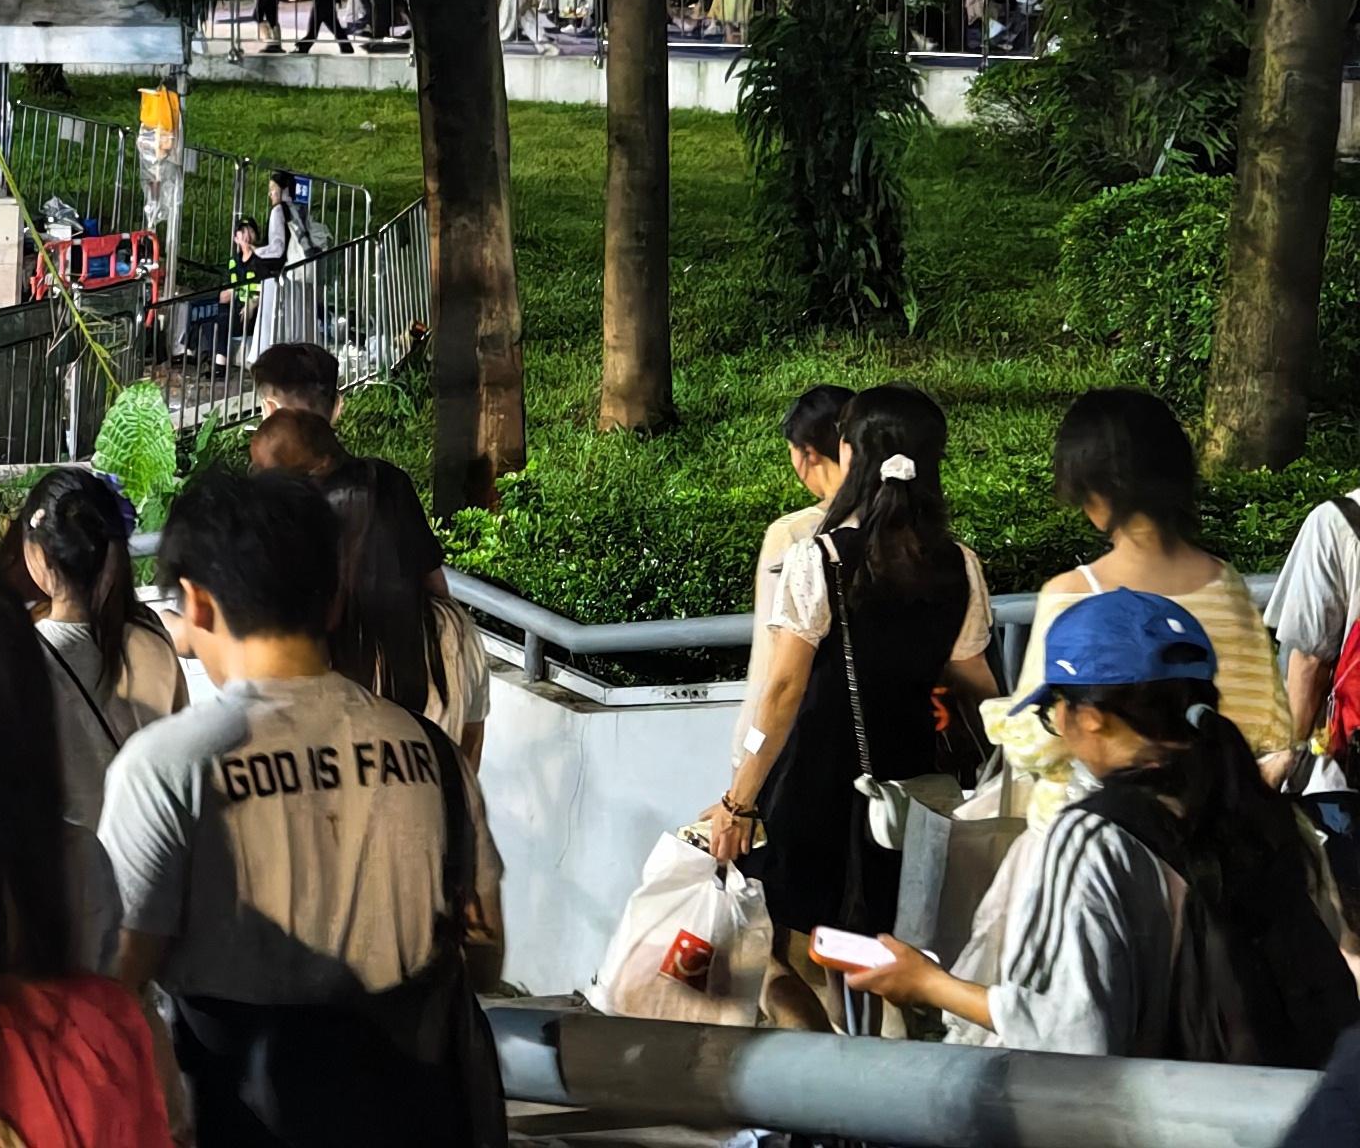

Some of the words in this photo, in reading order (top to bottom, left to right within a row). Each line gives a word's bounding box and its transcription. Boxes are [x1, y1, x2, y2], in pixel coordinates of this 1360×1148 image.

[221, 750, 302, 802] GOD
[306, 745, 342, 791] IS
[352, 739, 440, 787] FAIR
